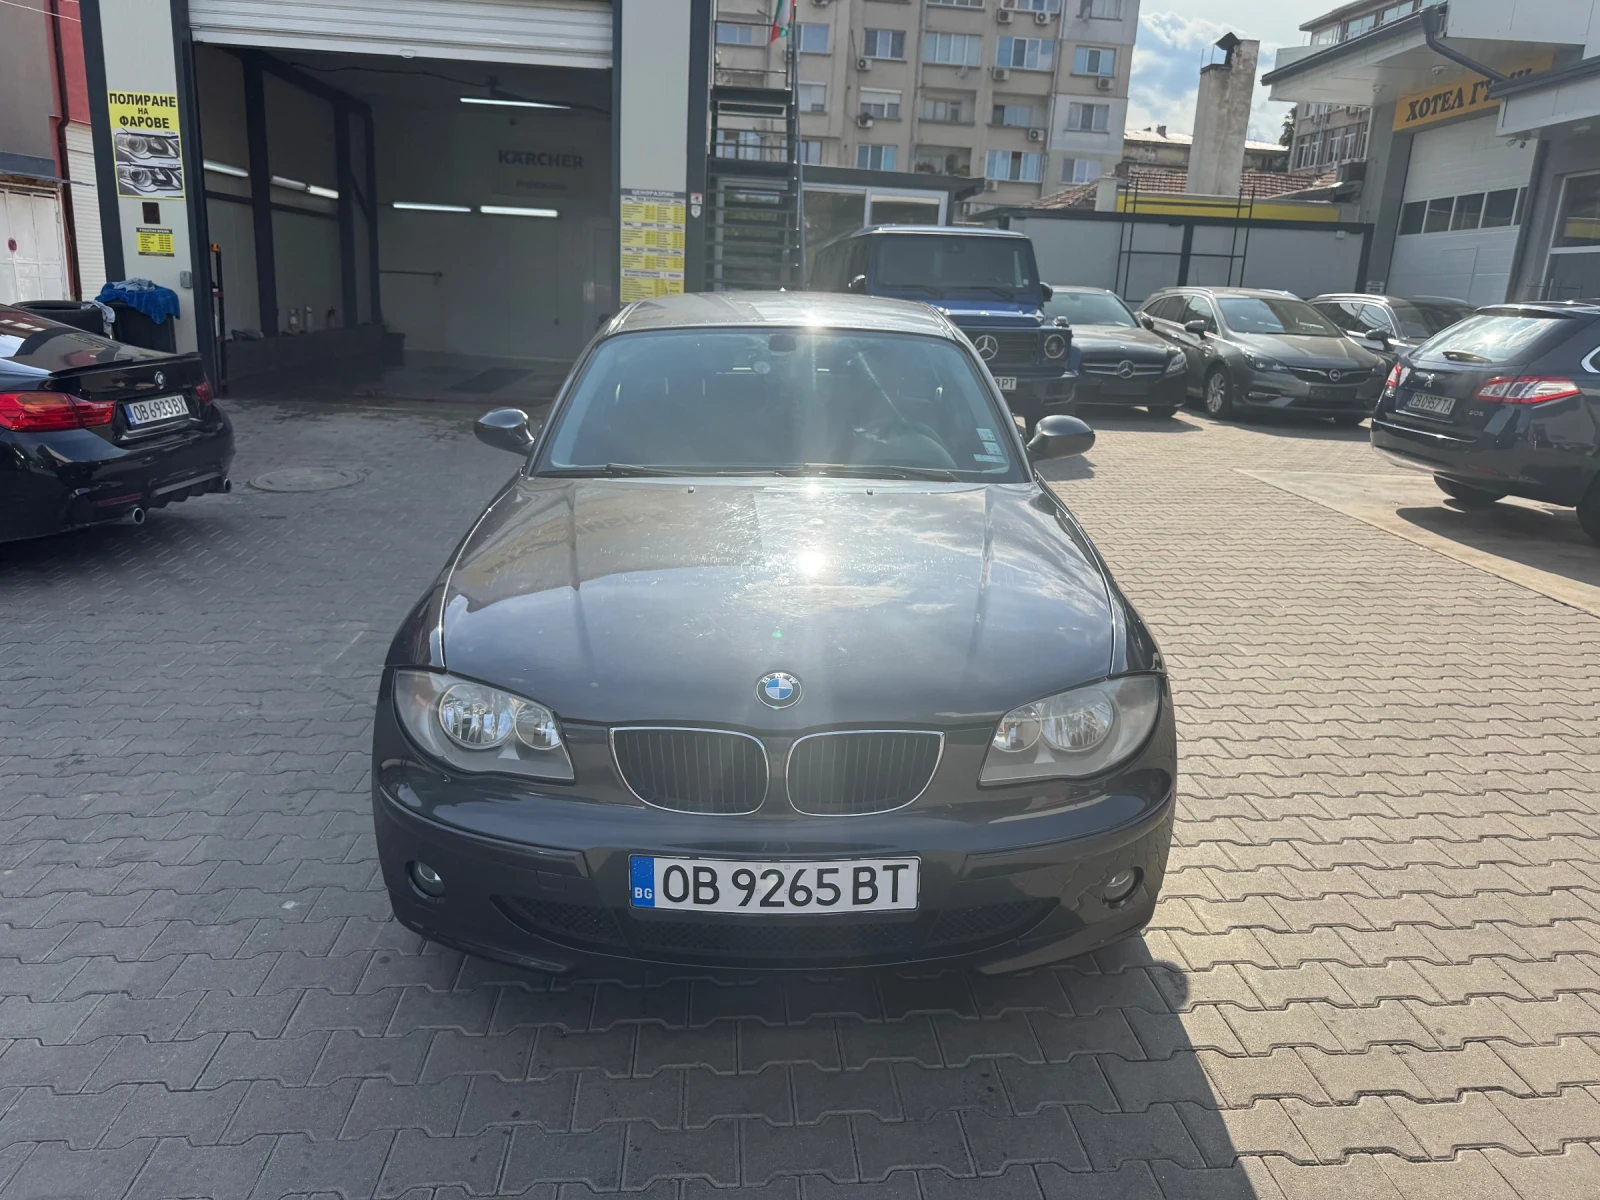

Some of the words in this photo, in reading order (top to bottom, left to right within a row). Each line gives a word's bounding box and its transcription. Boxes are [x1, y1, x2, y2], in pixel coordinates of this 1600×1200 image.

[109, 93, 177, 108] ПОЛИРАНЕ
[1405, 87, 1464, 122] ХОТЕЛ
[119, 115, 170, 129] ФАРОВЕ
[133, 404, 149, 421] OB
[149, 400, 173, 418] 6933
[171, 397, 187, 414] BX
[635, 887, 652, 899] BG
[662, 864, 720, 905] OB
[731, 867, 841, 907] 9265
[852, 864, 909, 905] BT
